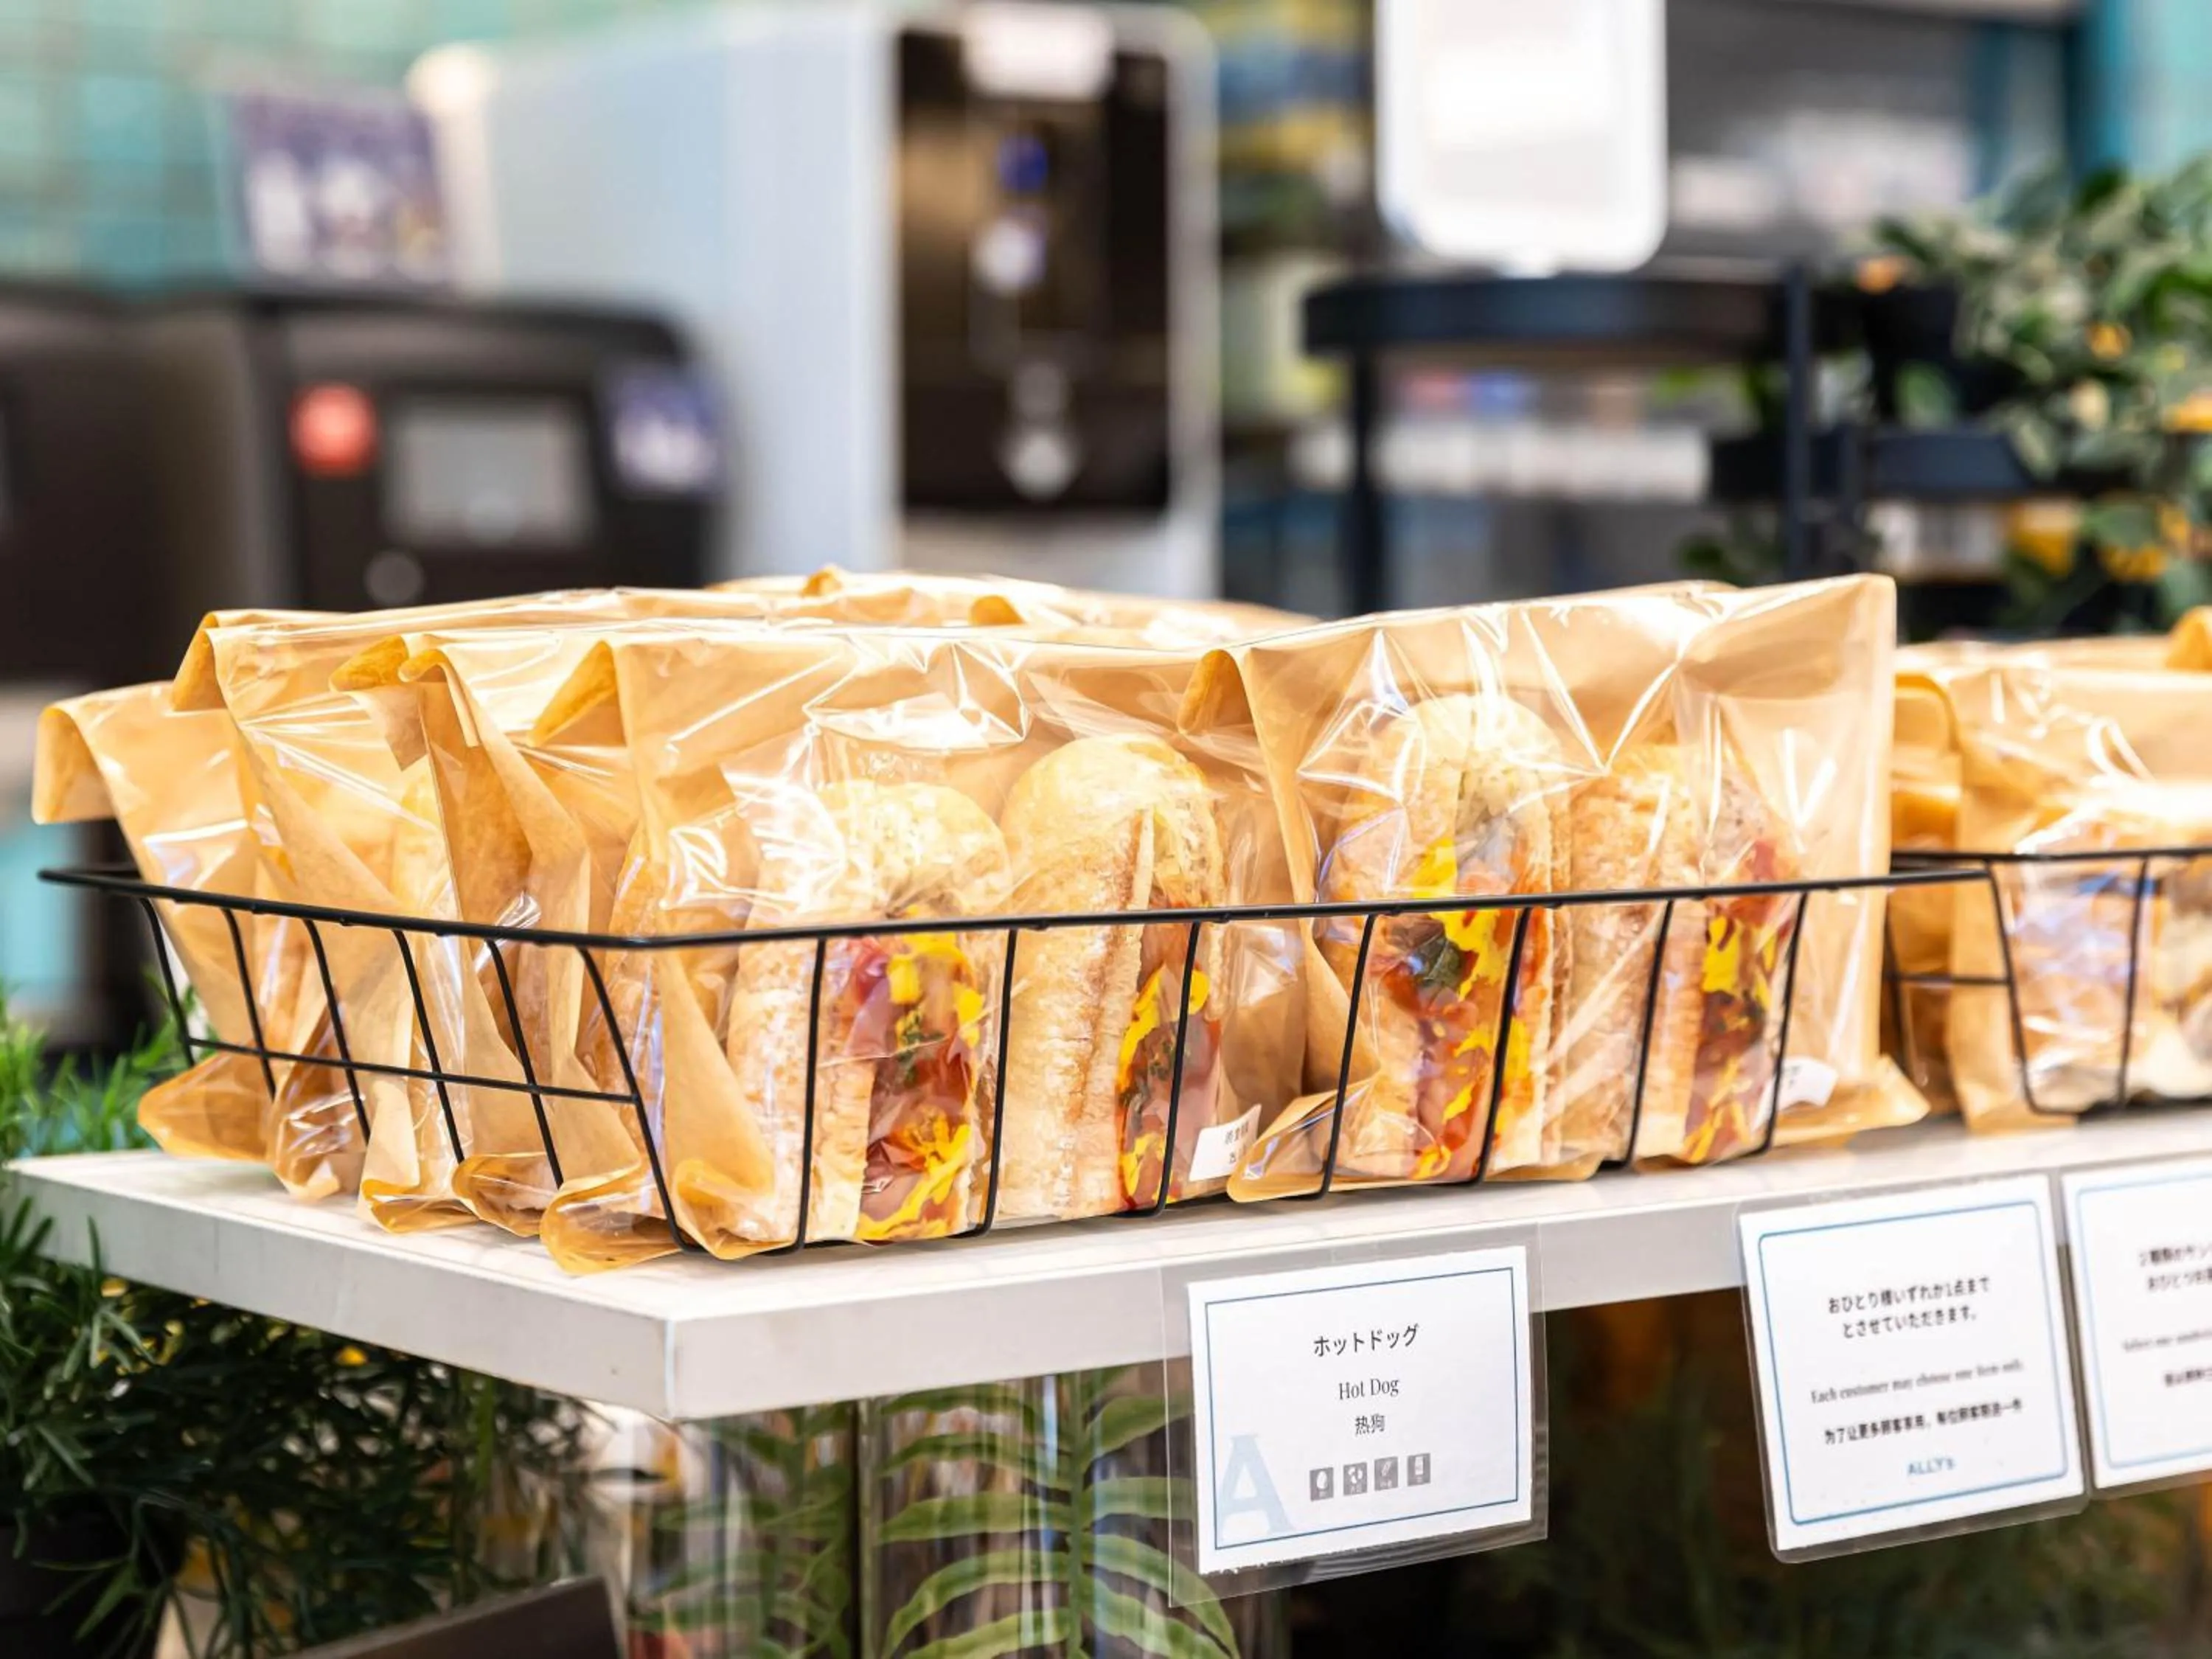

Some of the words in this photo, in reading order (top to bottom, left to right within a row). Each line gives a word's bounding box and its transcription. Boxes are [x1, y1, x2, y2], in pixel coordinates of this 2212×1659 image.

[1313, 1323, 1419, 1357] ホットドッグ
[1339, 1381, 1365, 1400] Hot
[1370, 1378, 1399, 1397] Dog
[1811, 1387, 1837, 1404] Each
[1354, 1413, 1385, 1436] 热狗
[1217, 1434, 1296, 1543] A
